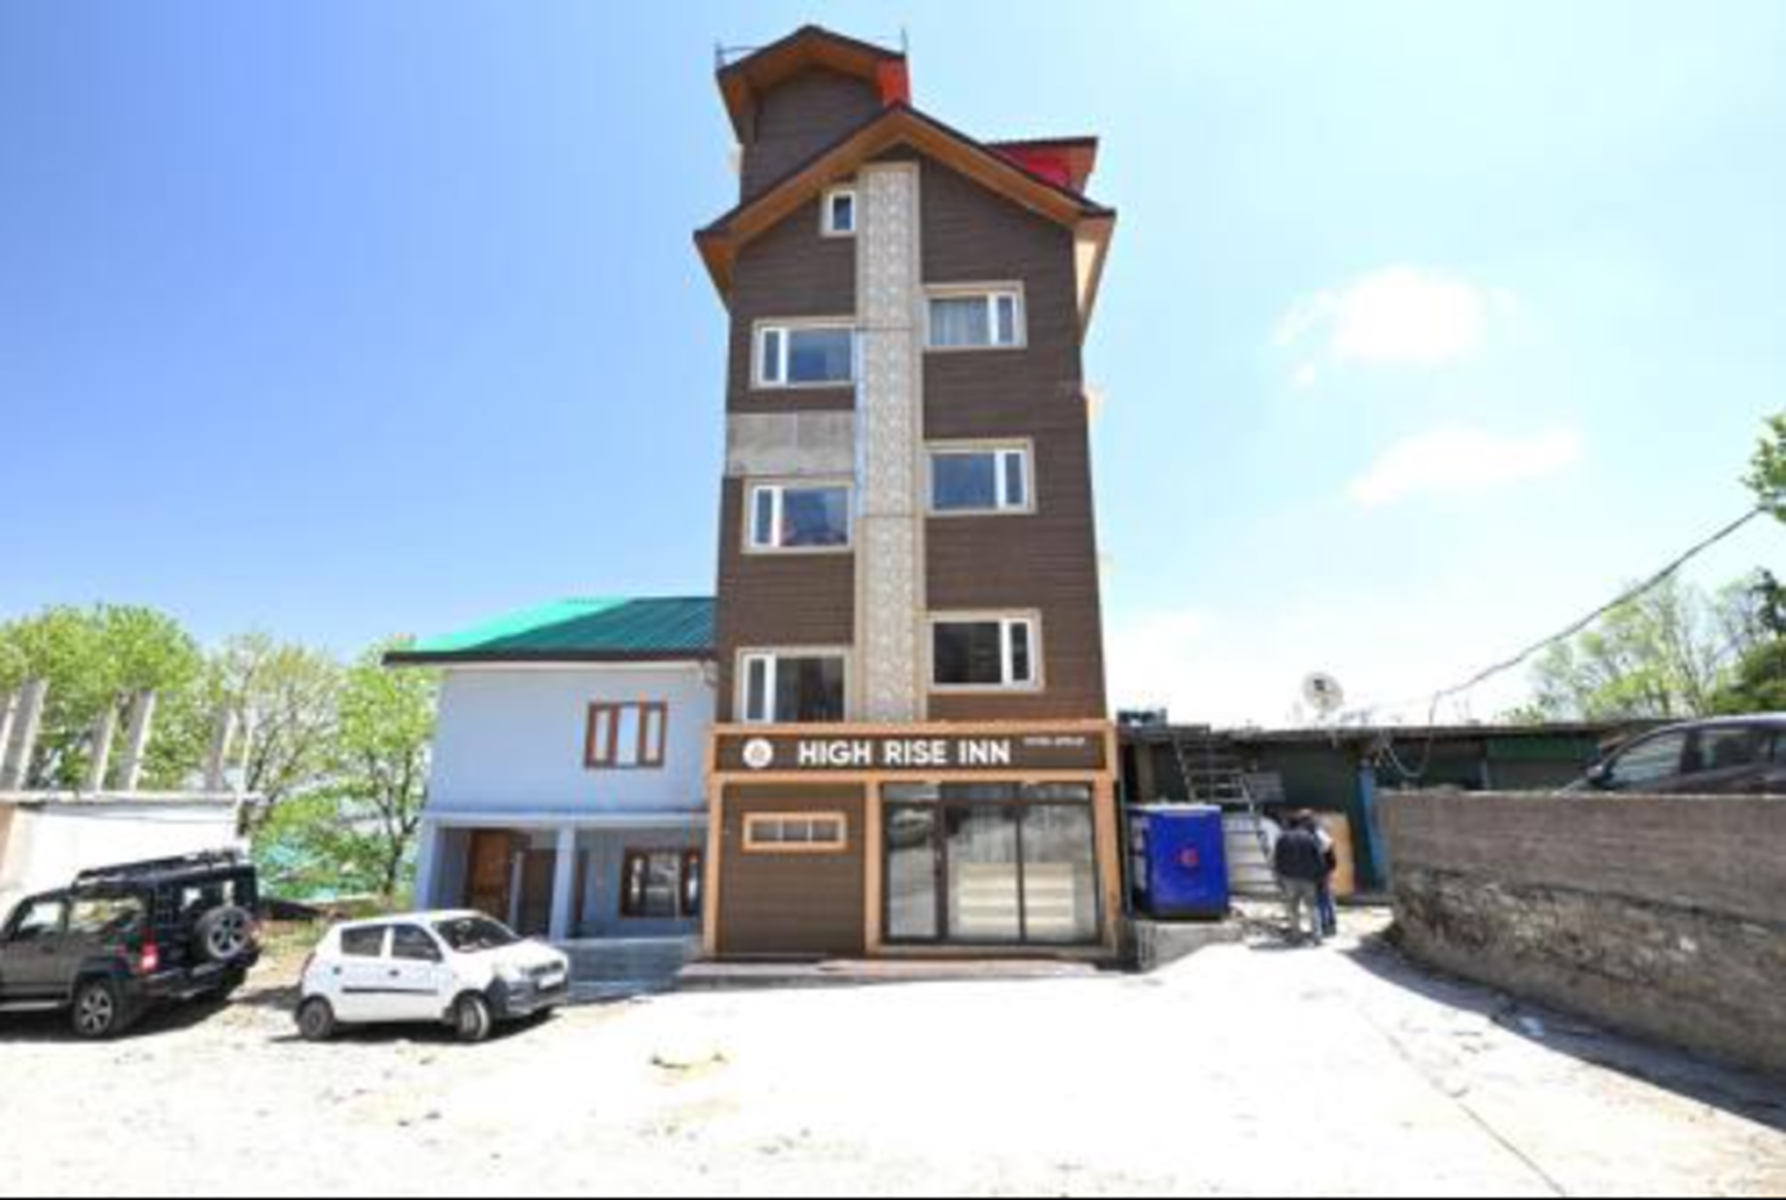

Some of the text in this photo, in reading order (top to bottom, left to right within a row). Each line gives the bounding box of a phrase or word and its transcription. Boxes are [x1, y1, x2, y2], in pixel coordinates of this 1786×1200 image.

[798, 739, 1010, 765] HIGH RISE INN
